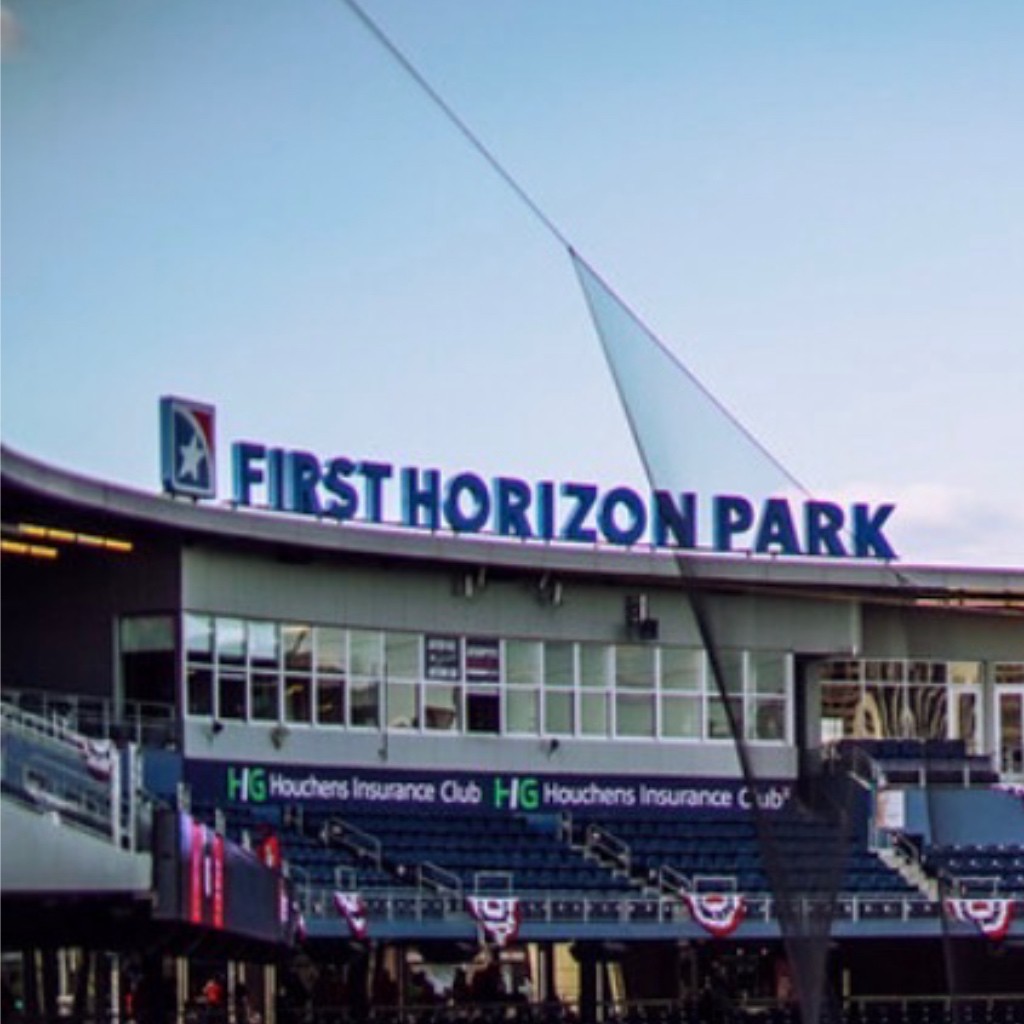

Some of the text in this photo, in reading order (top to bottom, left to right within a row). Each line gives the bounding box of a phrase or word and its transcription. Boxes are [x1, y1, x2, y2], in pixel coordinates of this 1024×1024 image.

[231, 441, 898, 559] FIRST HORIZON PARK
[269, 773, 350, 800] Houchens
[353, 776, 436, 803] Insurance
[440, 780, 483, 804] Club
[543, 782, 636, 806] Houchens
[640, 784, 733, 806] Insurance
[738, 786, 782, 809] Cub
